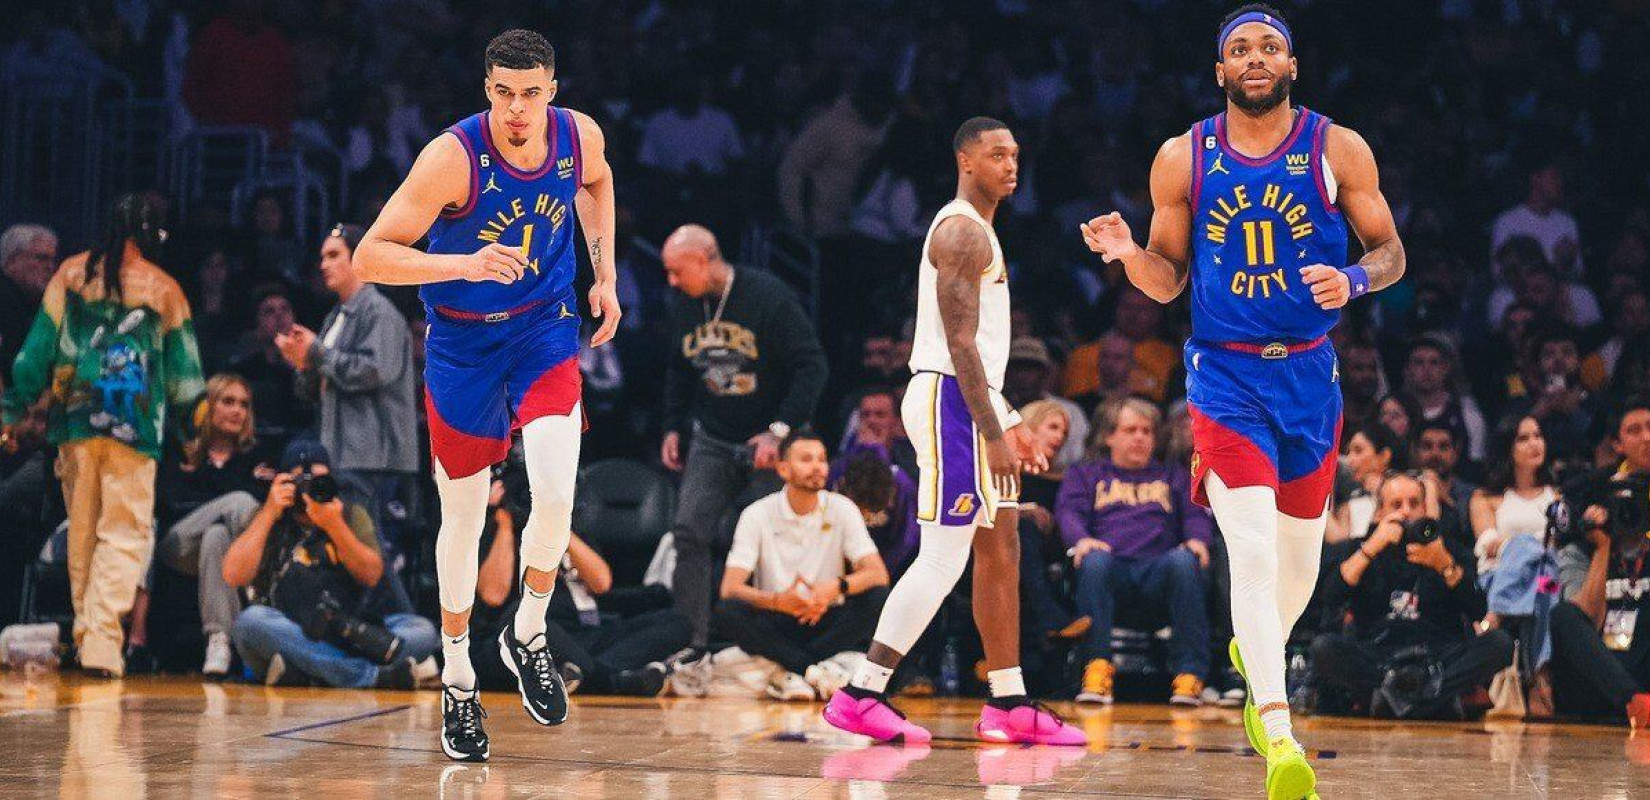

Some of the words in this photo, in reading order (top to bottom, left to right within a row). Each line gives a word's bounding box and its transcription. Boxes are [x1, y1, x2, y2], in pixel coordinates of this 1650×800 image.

[1205, 136, 1217, 149] 6
[480, 153, 490, 168] 6
[556, 156, 574, 170] WU
[1285, 152, 1309, 165] WU
[477, 197, 526, 243] MILE
[1206, 184, 1252, 244] MILE
[1262, 183, 1314, 240] HIGH
[521, 223, 534, 258] 1
[1242, 220, 1275, 266] 11
[1230, 268, 1287, 299] CITY
